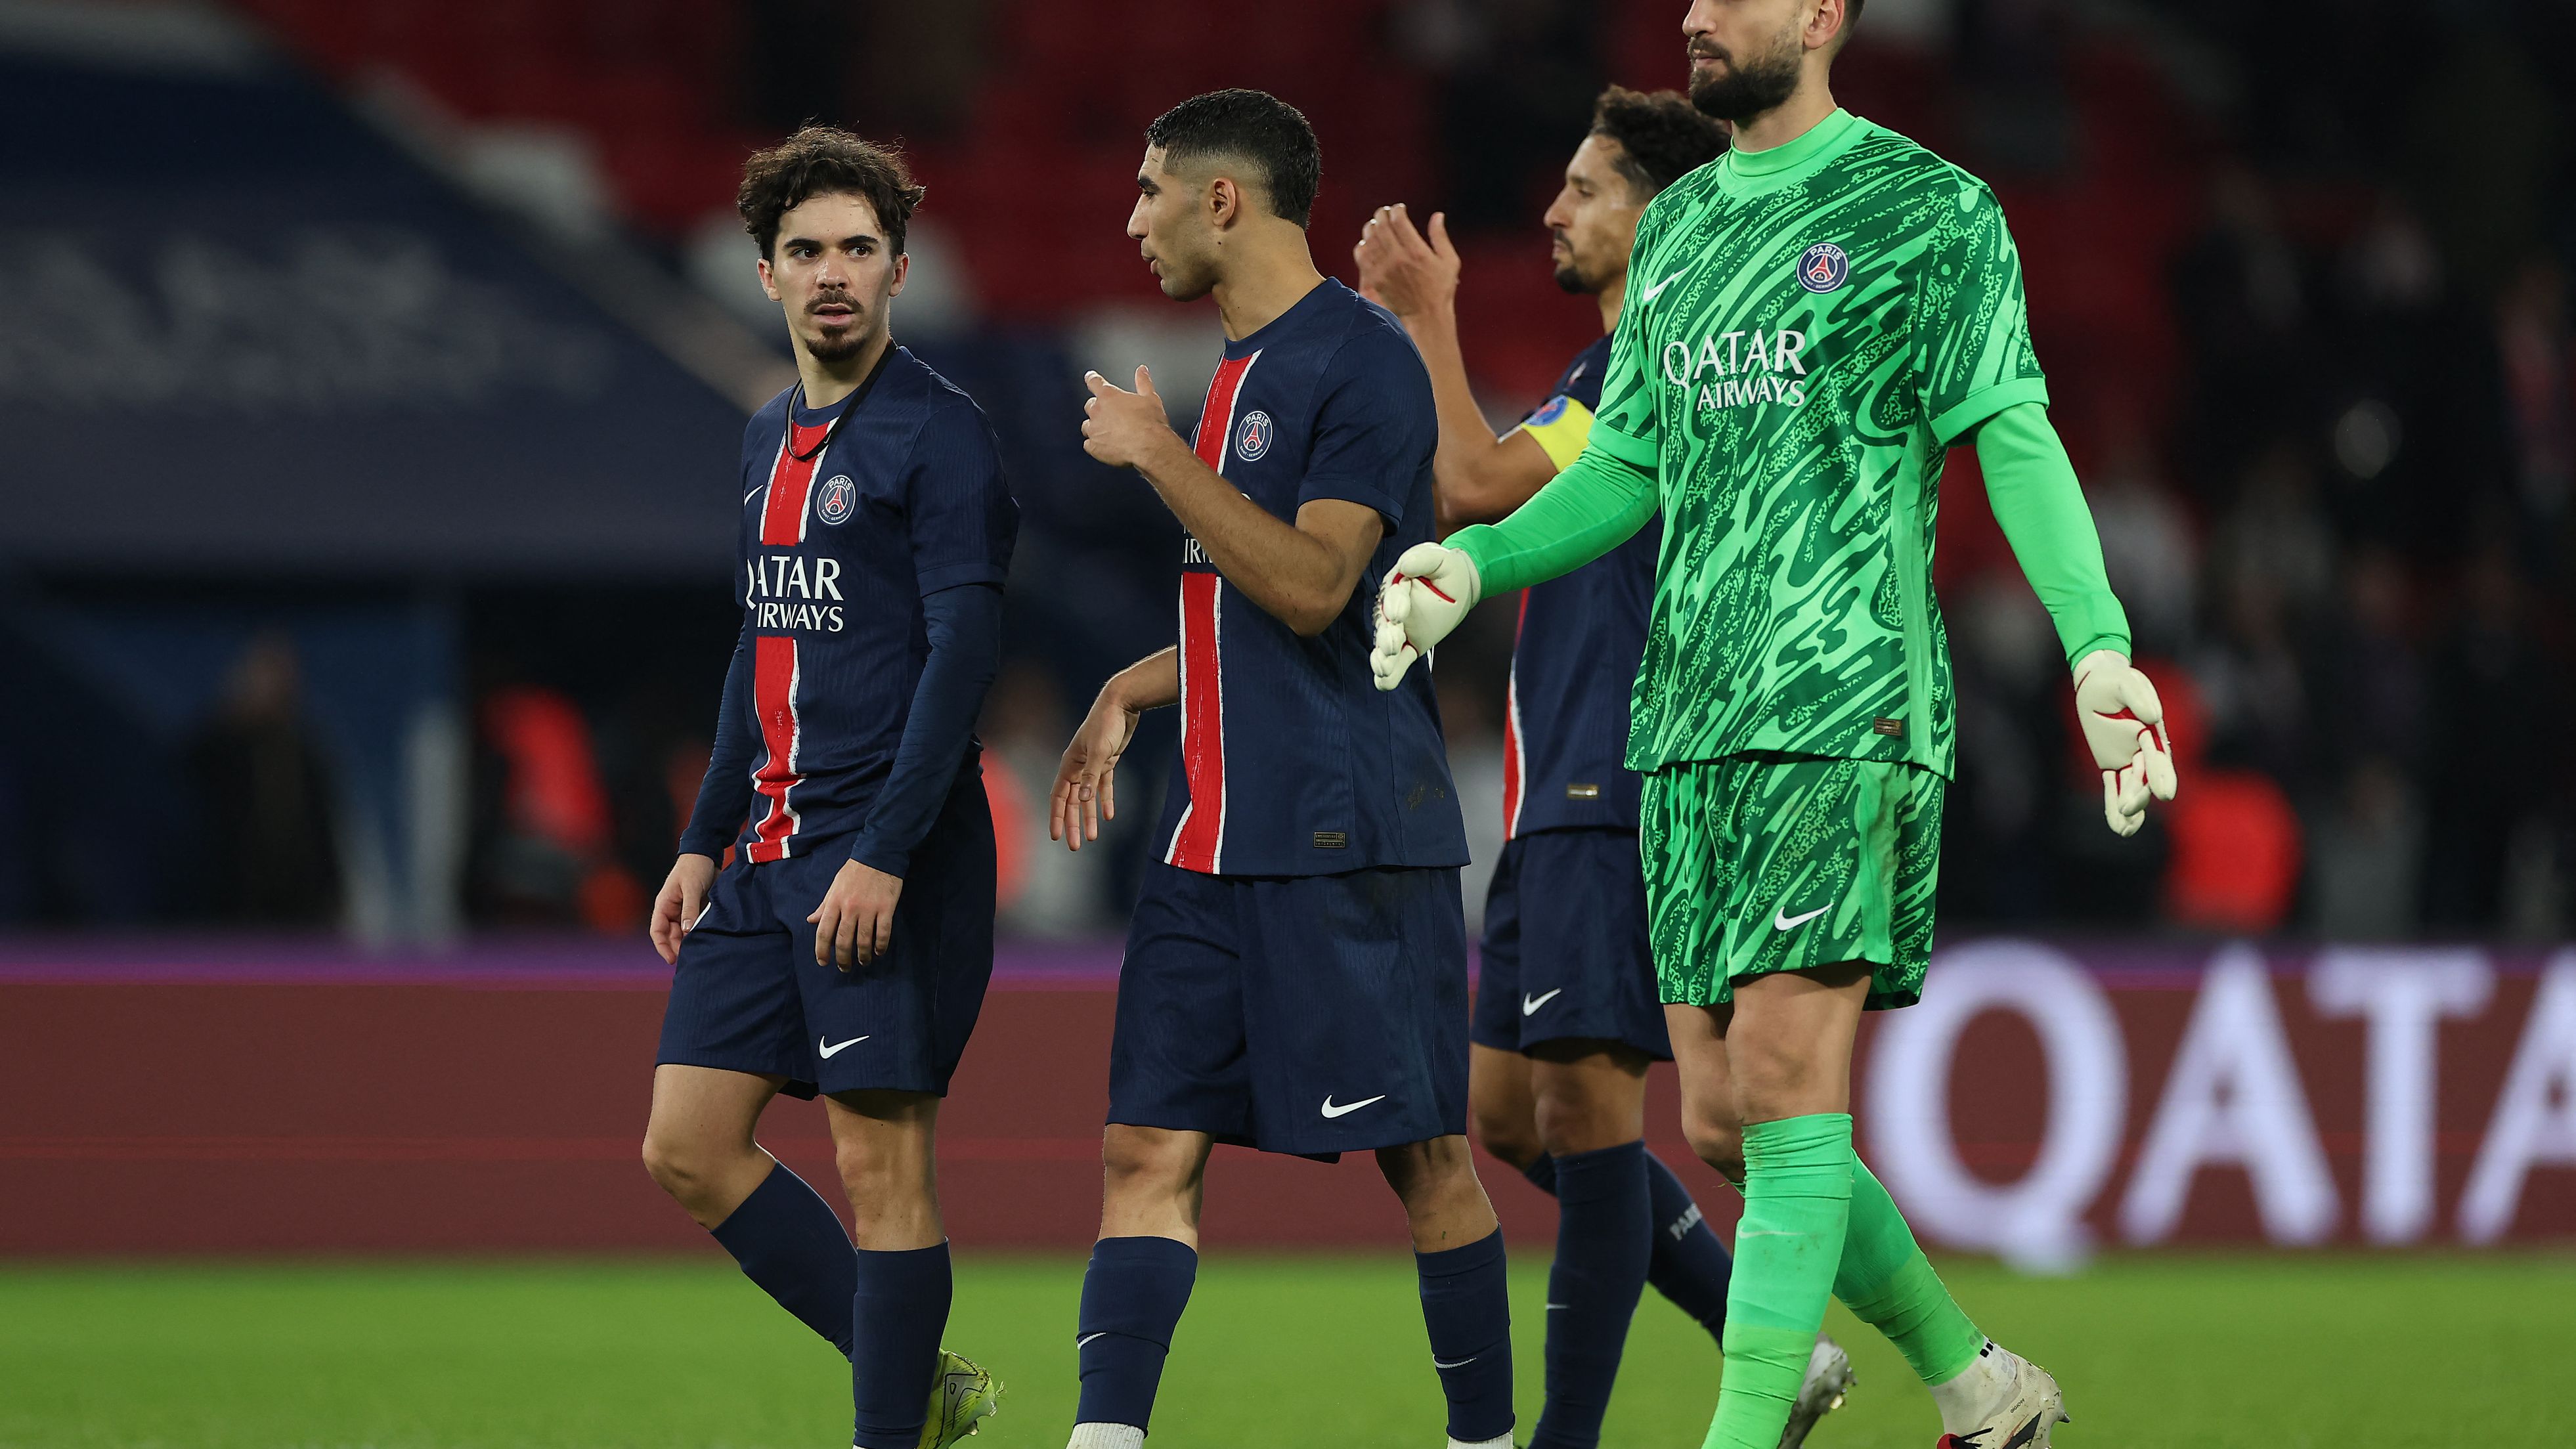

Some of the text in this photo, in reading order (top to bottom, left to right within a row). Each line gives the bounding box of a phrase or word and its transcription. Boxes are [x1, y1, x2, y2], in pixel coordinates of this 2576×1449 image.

[1810, 246, 1842, 260] PARIS
[1663, 329, 1806, 391] QATAR
[1697, 375, 1806, 411] AIRWAYS
[1246, 413, 1269, 427] PARIS
[829, 477, 852, 490] PARIS
[757, 602, 844, 632] IRWAYS
